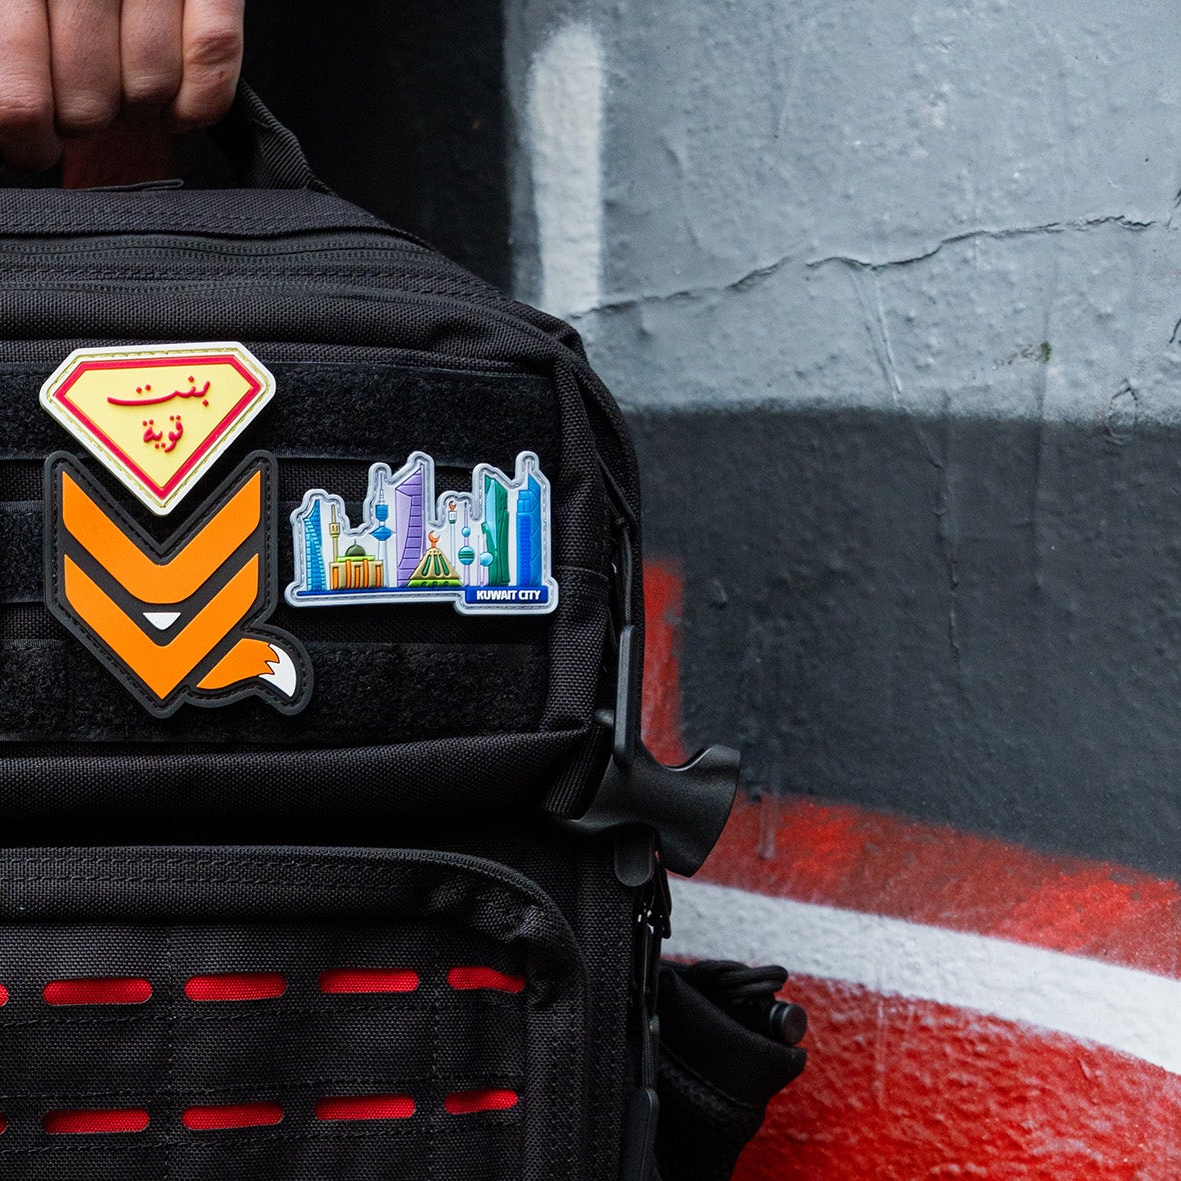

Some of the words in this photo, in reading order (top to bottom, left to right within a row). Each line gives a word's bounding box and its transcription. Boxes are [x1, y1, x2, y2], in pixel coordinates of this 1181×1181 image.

[107, 375, 211, 407] بنت
[142, 415, 184, 453] قوية
[476, 590, 517, 600] KUWAIT
[518, 590, 541, 600] CITY
